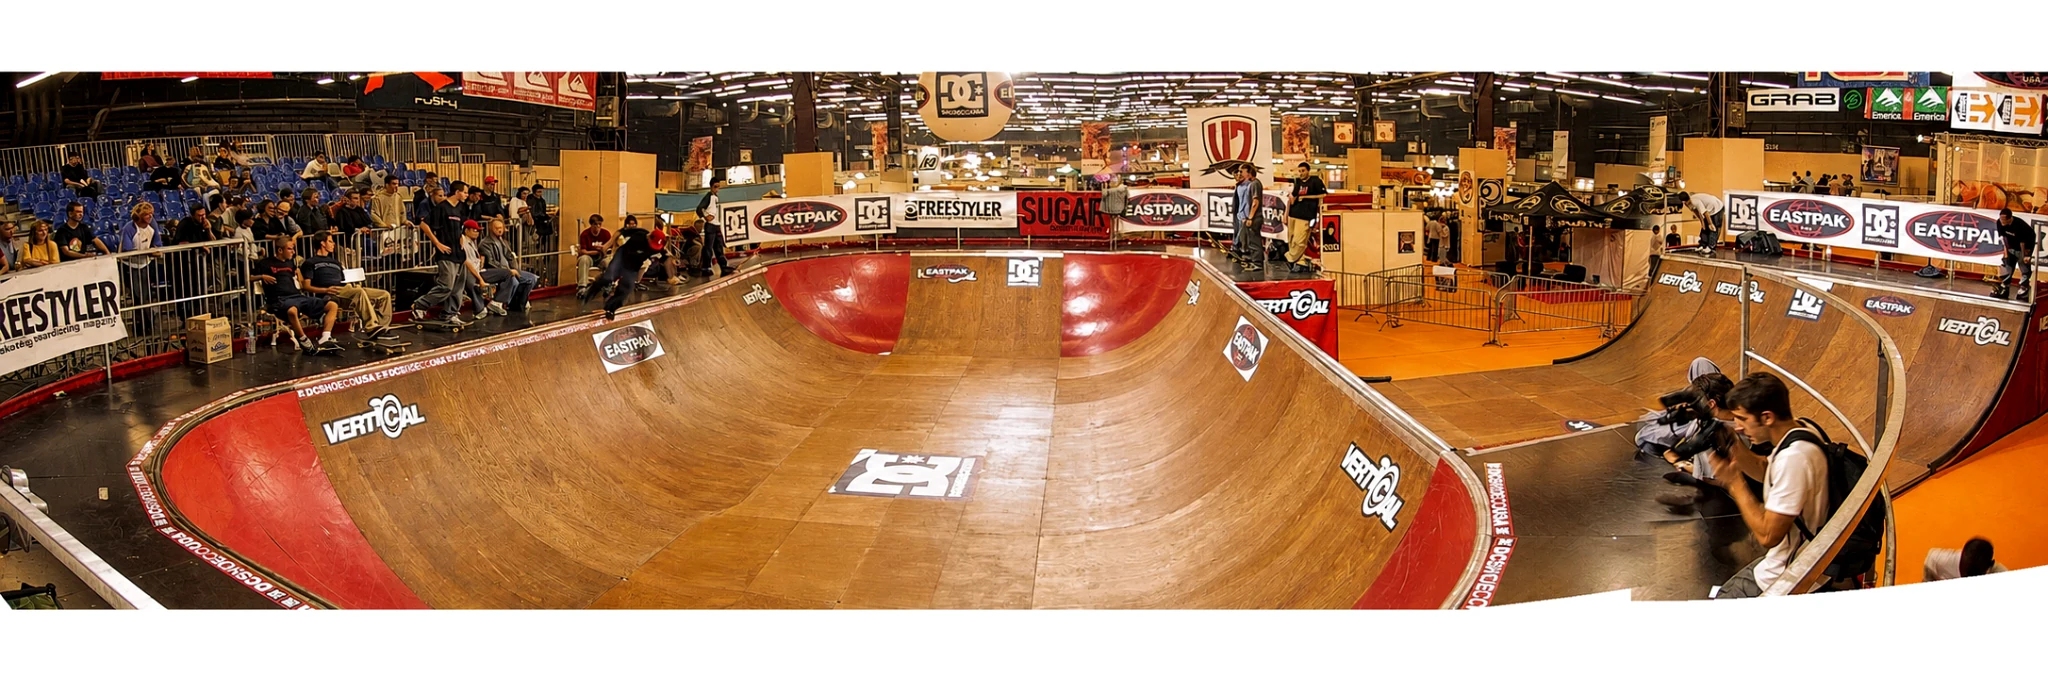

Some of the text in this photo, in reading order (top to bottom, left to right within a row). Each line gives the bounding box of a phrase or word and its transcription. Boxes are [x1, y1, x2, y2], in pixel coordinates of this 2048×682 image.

[1750, 93, 1837, 107] GRAB
[1872, 112, 1902, 120] Emerica
[1914, 112, 1946, 121] Emerica
[760, 209, 840, 227] EASTPAK
[918, 200, 1002, 216] FREESTYLER
[1021, 196, 1105, 227] SUGAR
[1126, 203, 1195, 216] EASTPAK
[1770, 203, 1846, 228] EASTPAK
[1255, 290, 1330, 320] ERTICAL
[1866, 301, 1912, 314] EASTPAK
[1938, 316, 2010, 346] VERTICAL
[603, 334, 654, 358] EASTPAK
[1232, 332, 1260, 364] EASTPAK
[322, 395, 426, 444] VERTICAL
[1341, 443, 1403, 531] VERTICAL
